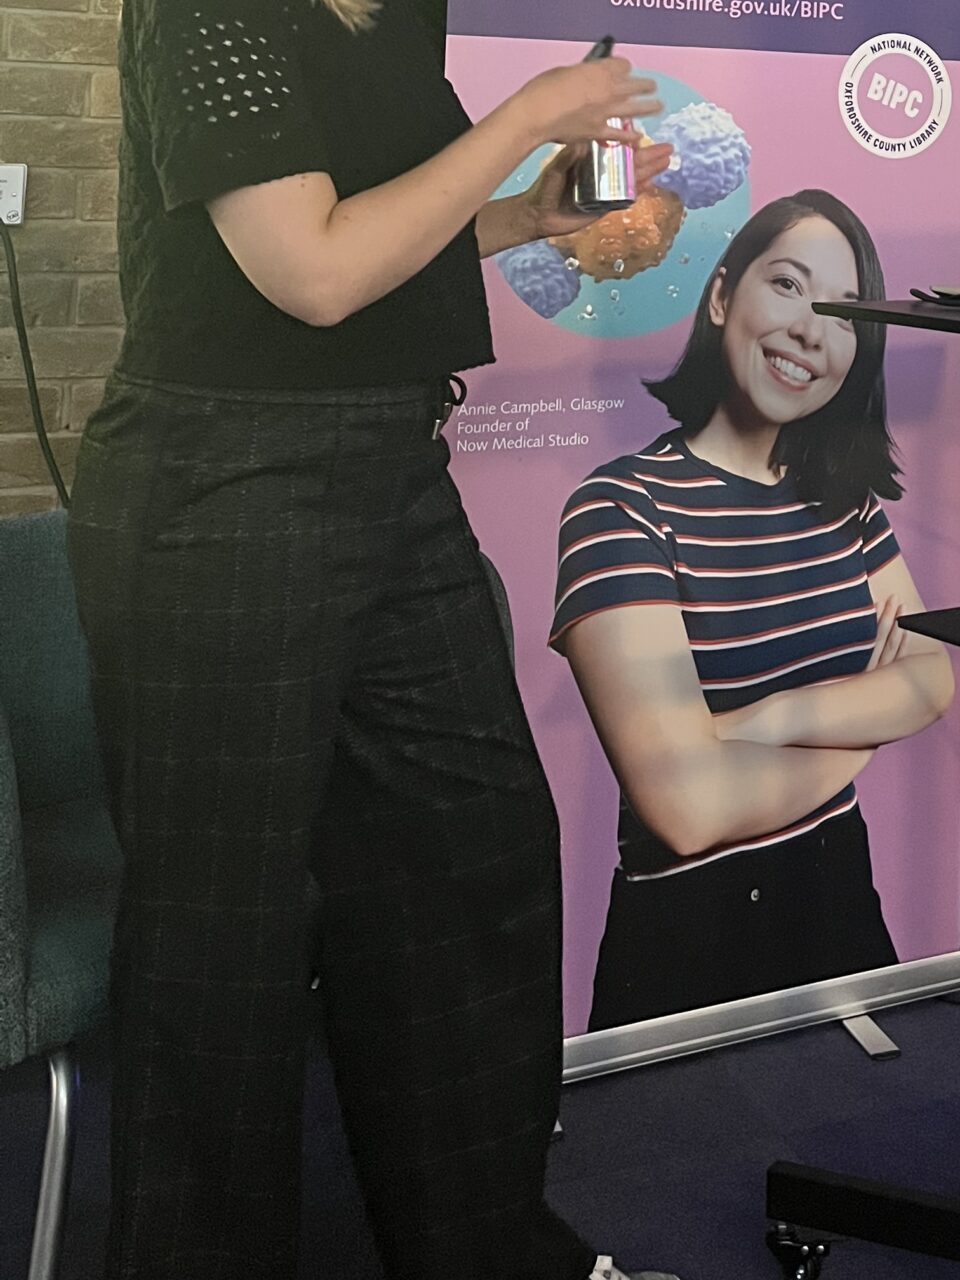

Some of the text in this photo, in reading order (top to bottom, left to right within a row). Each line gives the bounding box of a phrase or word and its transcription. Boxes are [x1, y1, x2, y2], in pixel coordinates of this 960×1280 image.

[870, 39, 944, 84] NATIONAL NETWORK
[866, 72, 924, 118] BIPC
[844, 81, 939, 152] OXFORDSHIRE COUNTY LIBRARY
[457, 397, 625, 417] Annie Campbell, Glasgow
[457, 418, 531, 435] Founder of
[456, 433, 589, 453] Now Medical Studio
